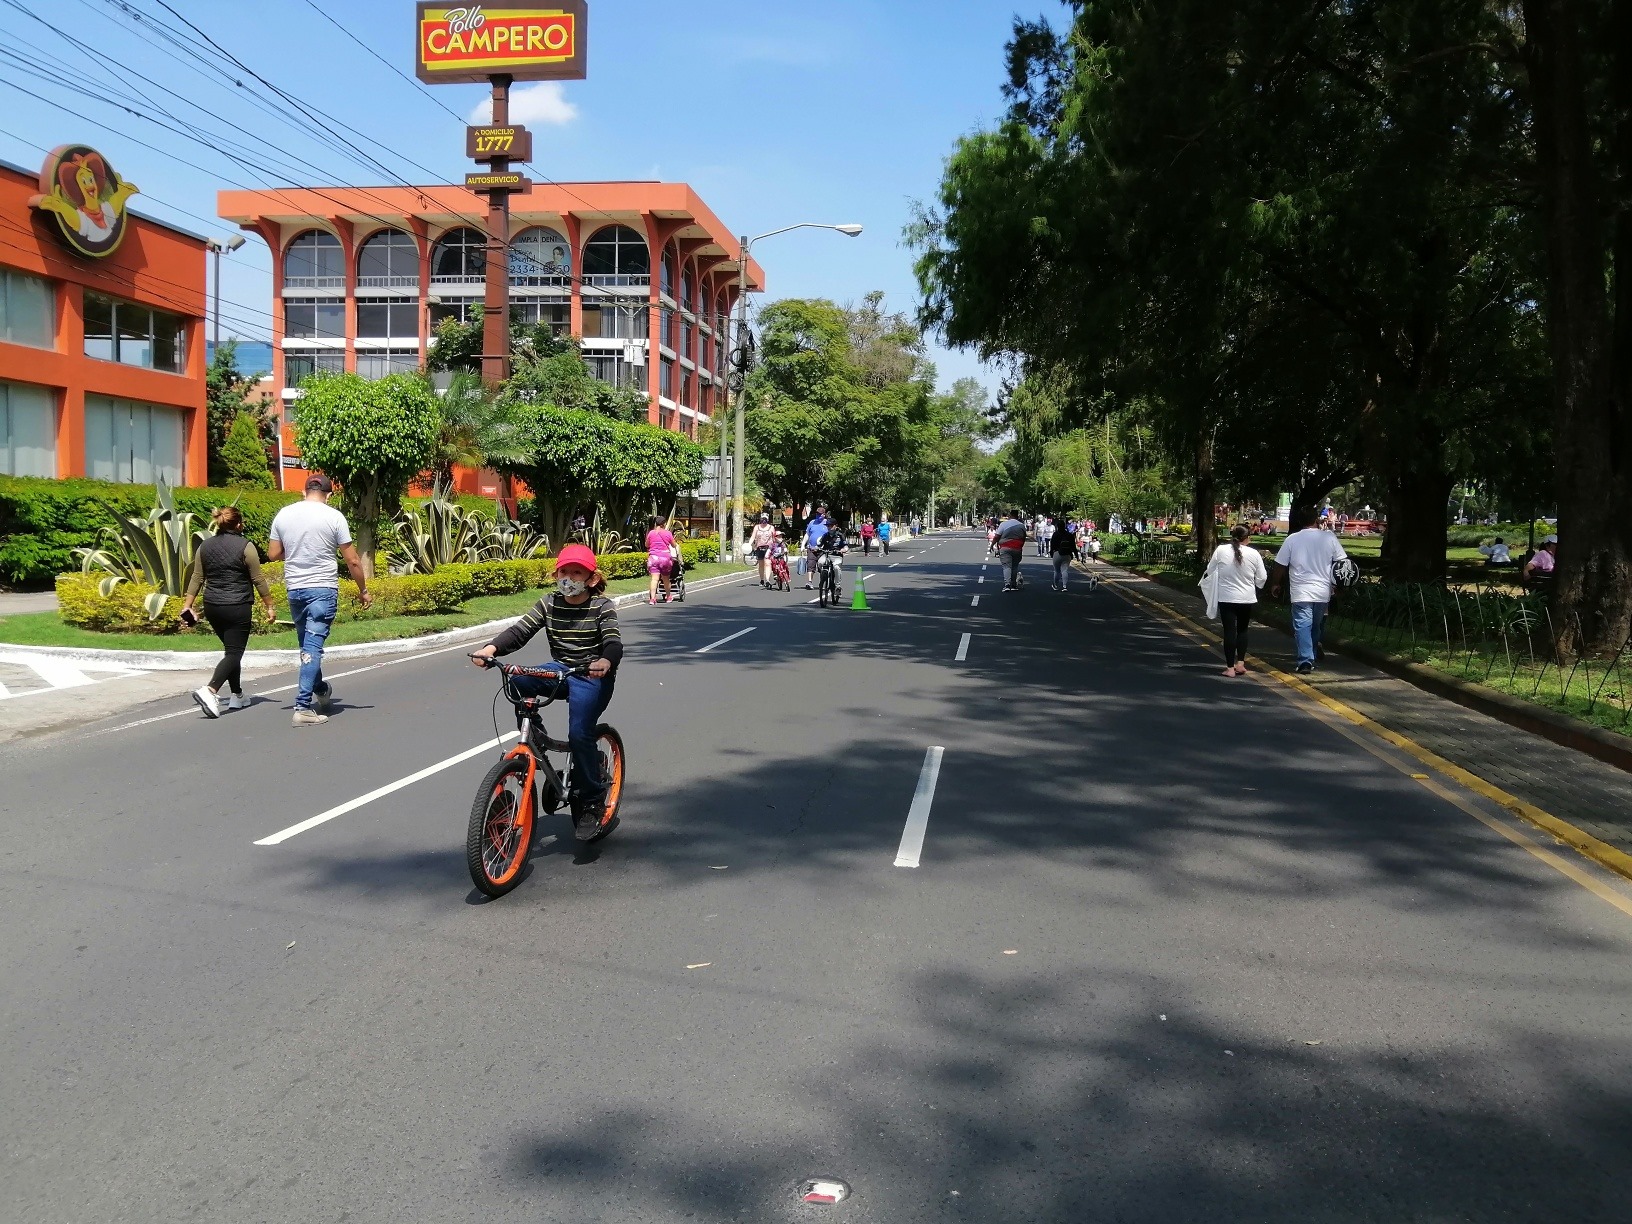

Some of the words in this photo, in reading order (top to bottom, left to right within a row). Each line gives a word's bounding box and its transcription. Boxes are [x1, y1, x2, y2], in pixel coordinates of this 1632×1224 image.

[444, 5, 486, 34] Pollo
[427, 24, 569, 54] CAMPERO
[475, 135, 514, 152] 1777
[467, 175, 519, 185] AUTOSERVICIO
